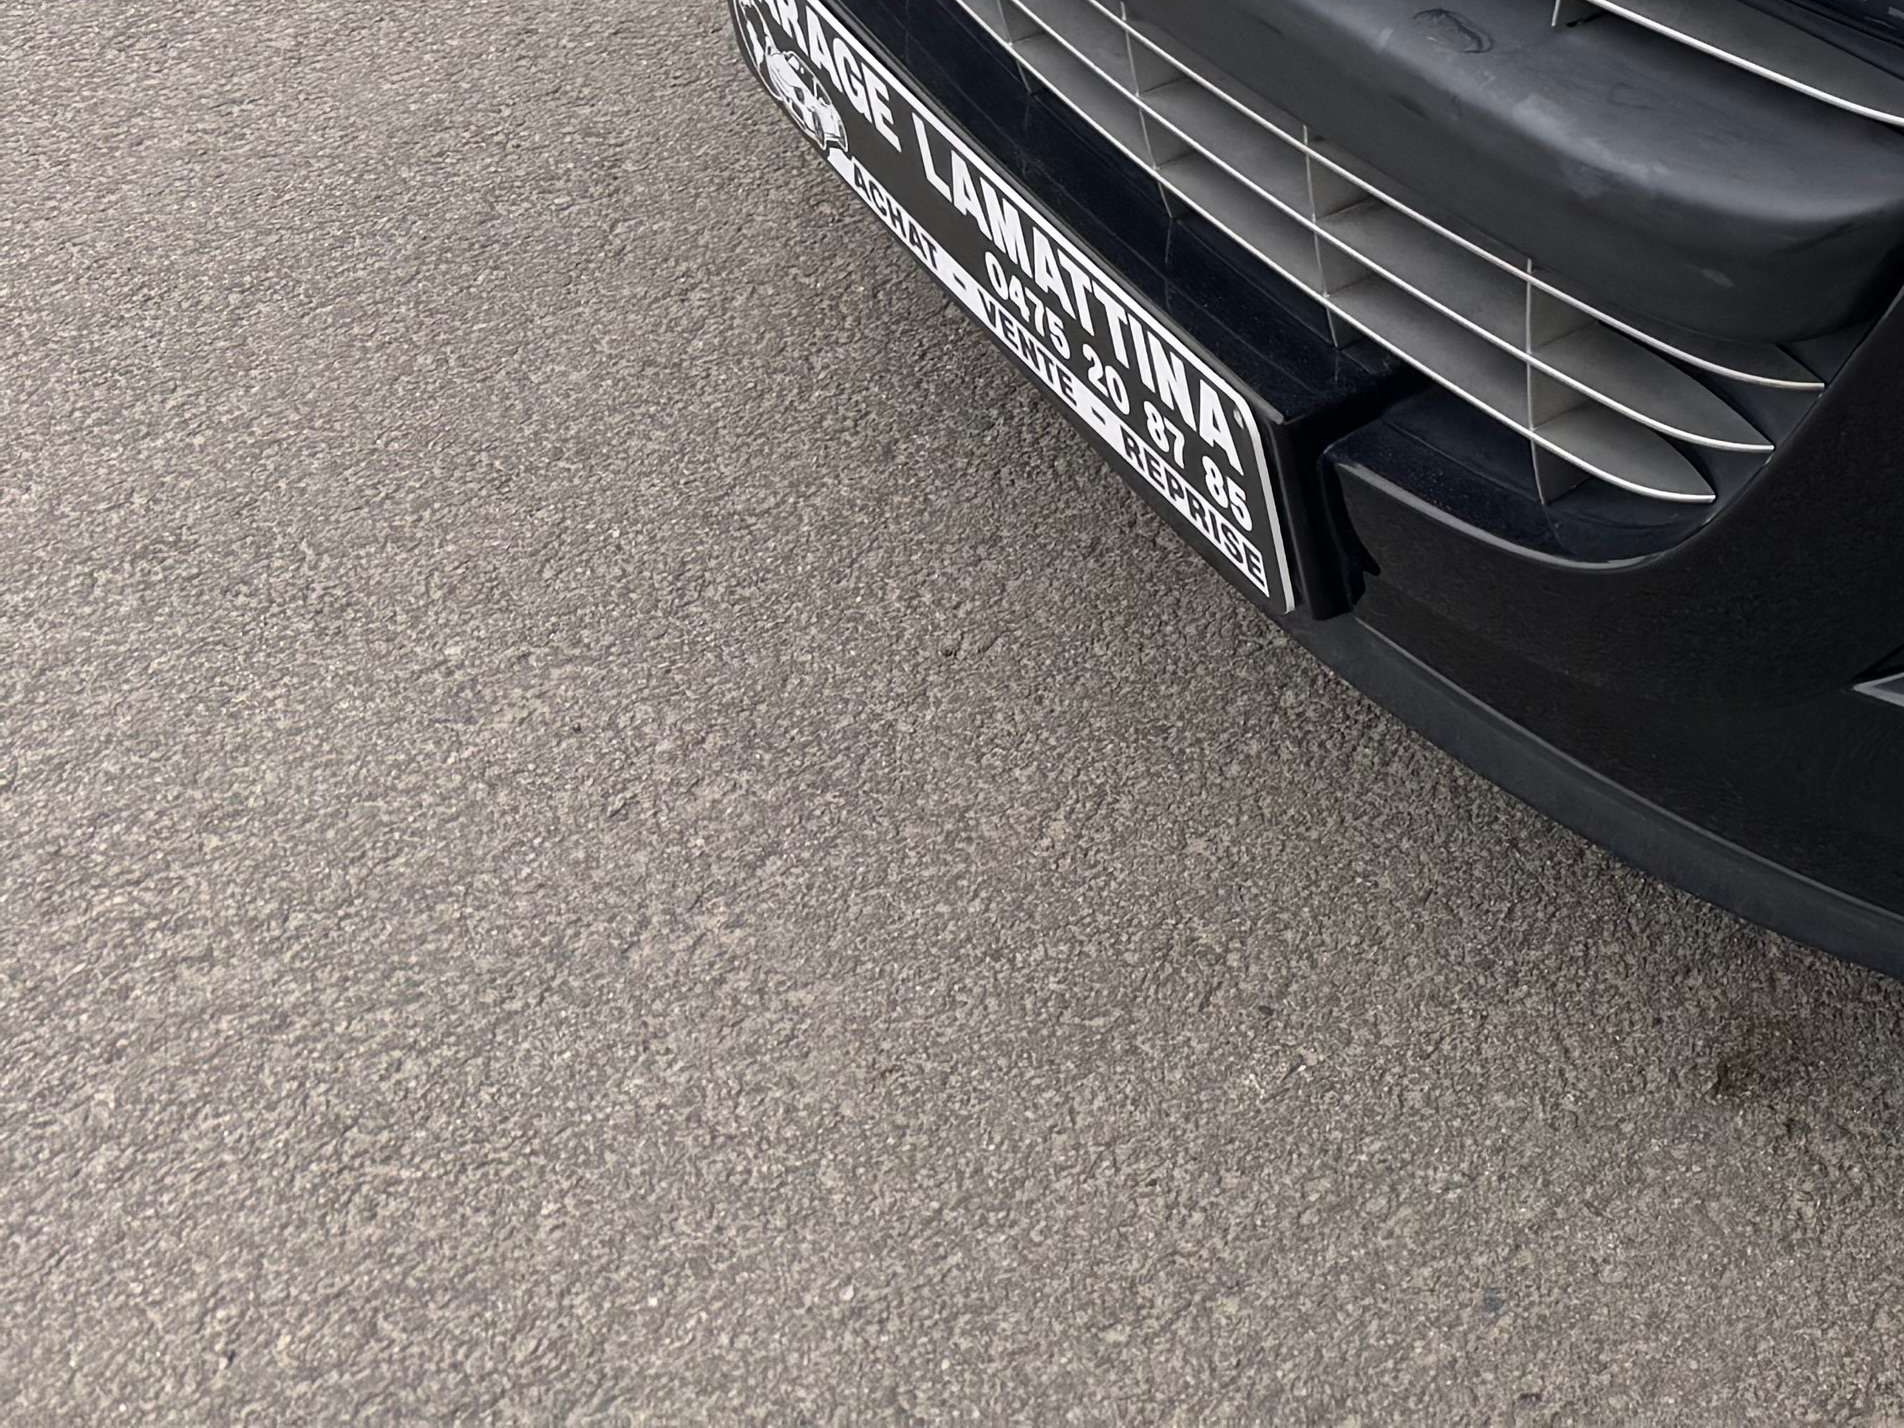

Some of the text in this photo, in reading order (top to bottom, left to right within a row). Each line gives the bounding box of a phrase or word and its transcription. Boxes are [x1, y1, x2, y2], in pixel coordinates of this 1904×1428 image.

[852, 162, 938, 270] ACHAT
[977, 287, 1078, 407] VENTE
[1119, 425, 1265, 588] REPRISE
[912, 112, 1245, 477] LAMATTINA
[985, 251, 1253, 532] 0475 20 87 85
